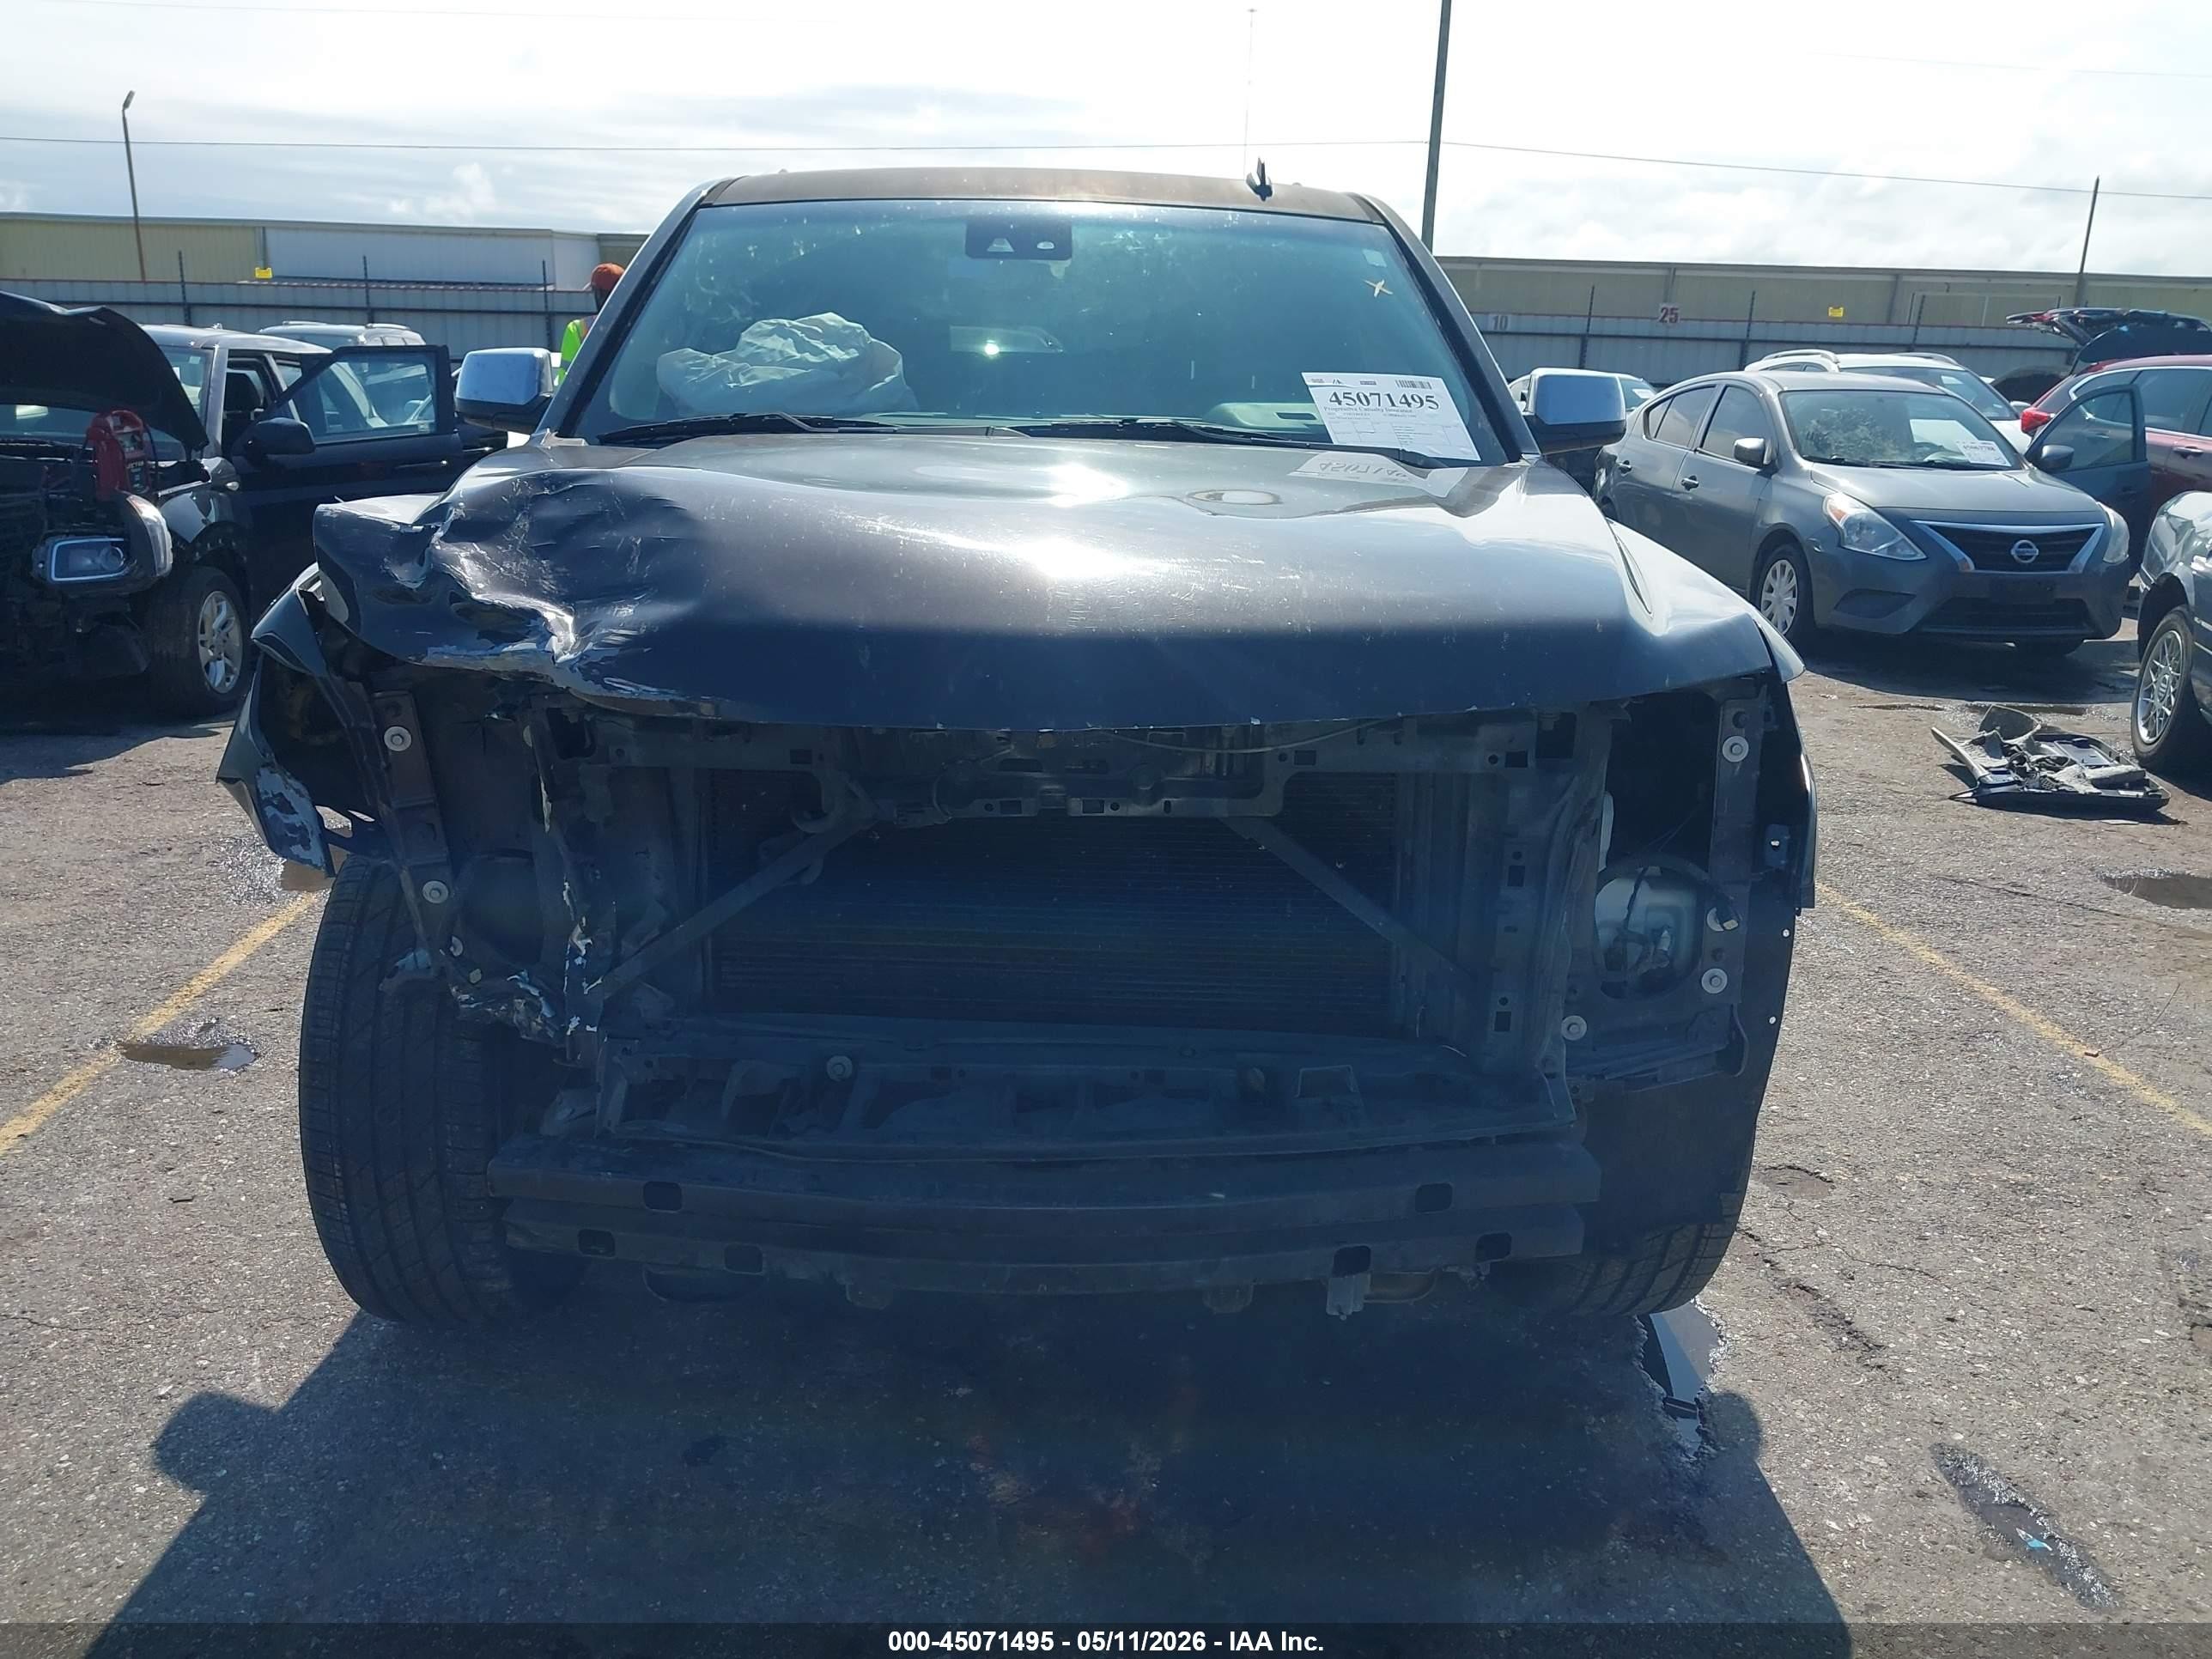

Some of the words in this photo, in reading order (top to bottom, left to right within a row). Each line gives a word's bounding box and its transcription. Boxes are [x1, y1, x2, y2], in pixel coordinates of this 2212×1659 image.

[1492, 315, 1509, 331] 10
[1658, 307, 1680, 324] 25
[1328, 391, 1439, 410] 45071495
